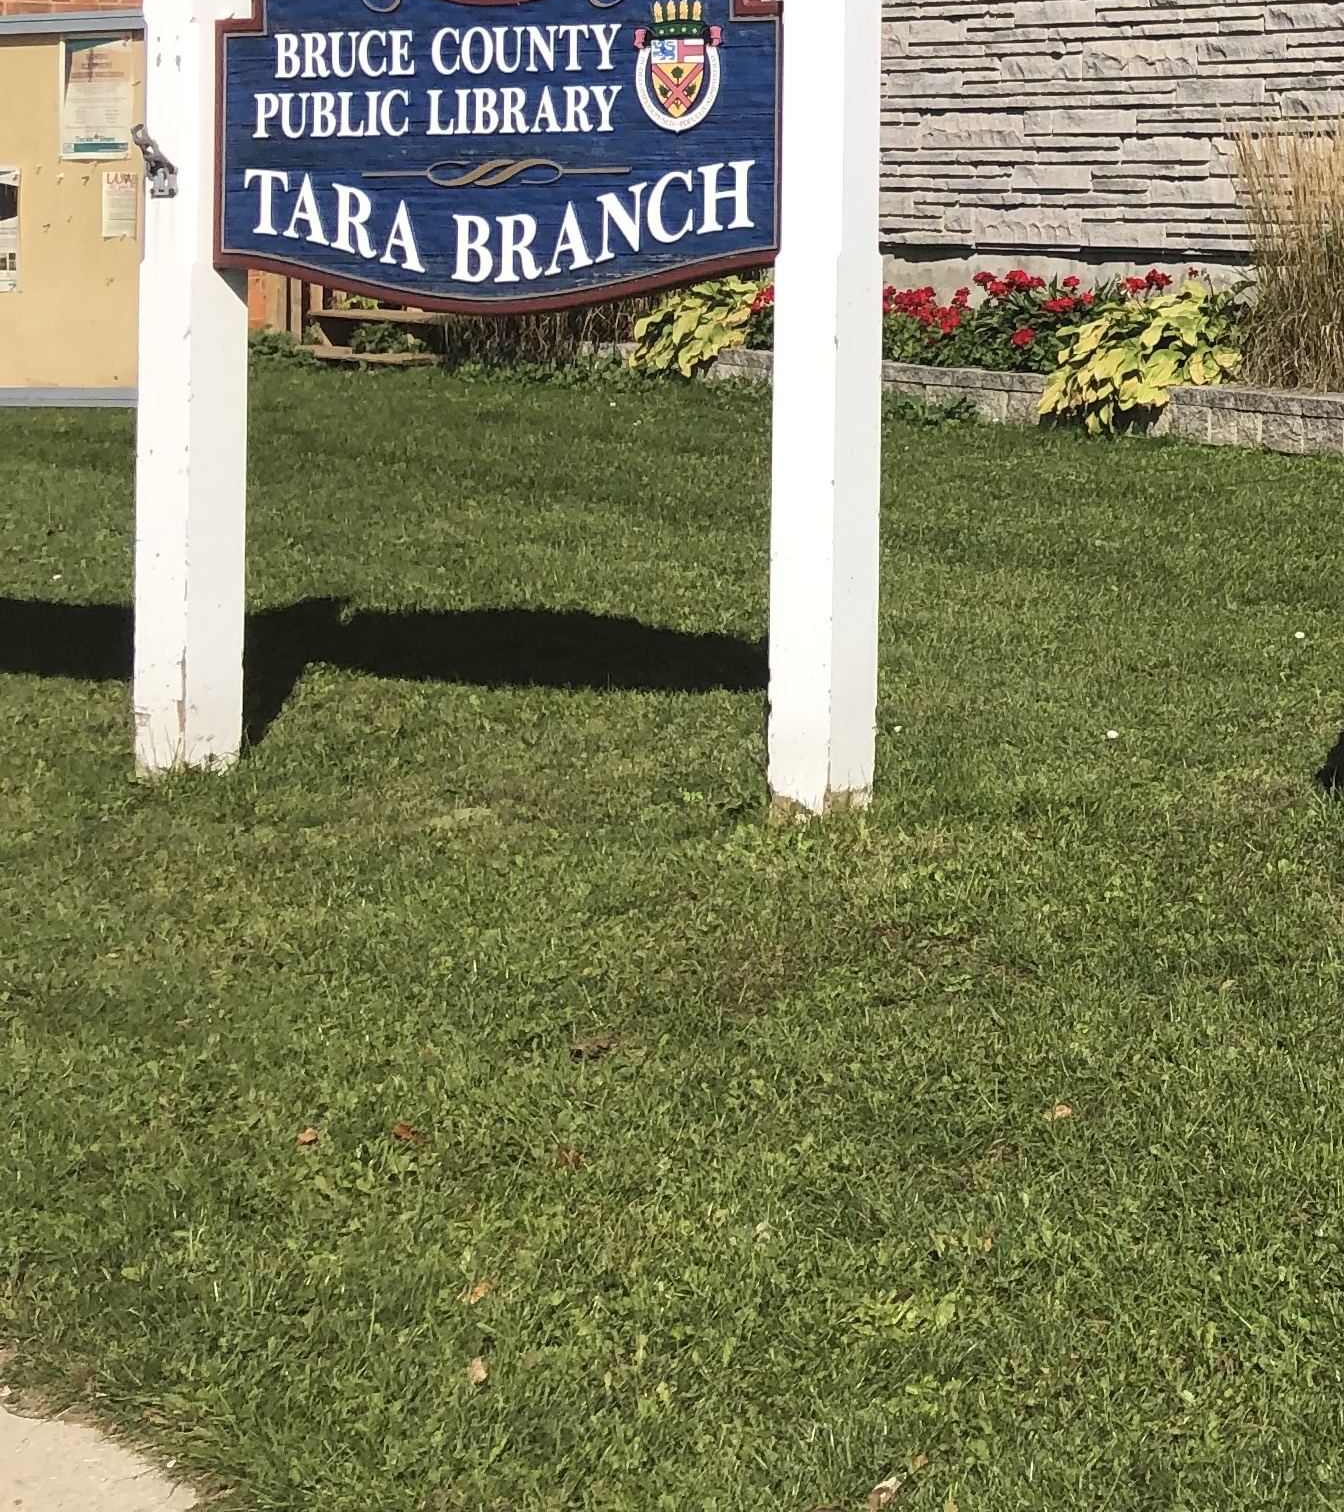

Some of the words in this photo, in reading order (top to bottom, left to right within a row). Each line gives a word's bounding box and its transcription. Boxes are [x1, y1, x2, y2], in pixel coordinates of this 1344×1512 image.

[274, 29, 416, 79] BRUCE
[431, 24, 622, 75] COUNTY
[252, 89, 410, 139] PUBLIC
[425, 85, 622, 136] LIBRARY
[244, 168, 428, 273] TARA
[451, 159, 757, 284] BRANCH
